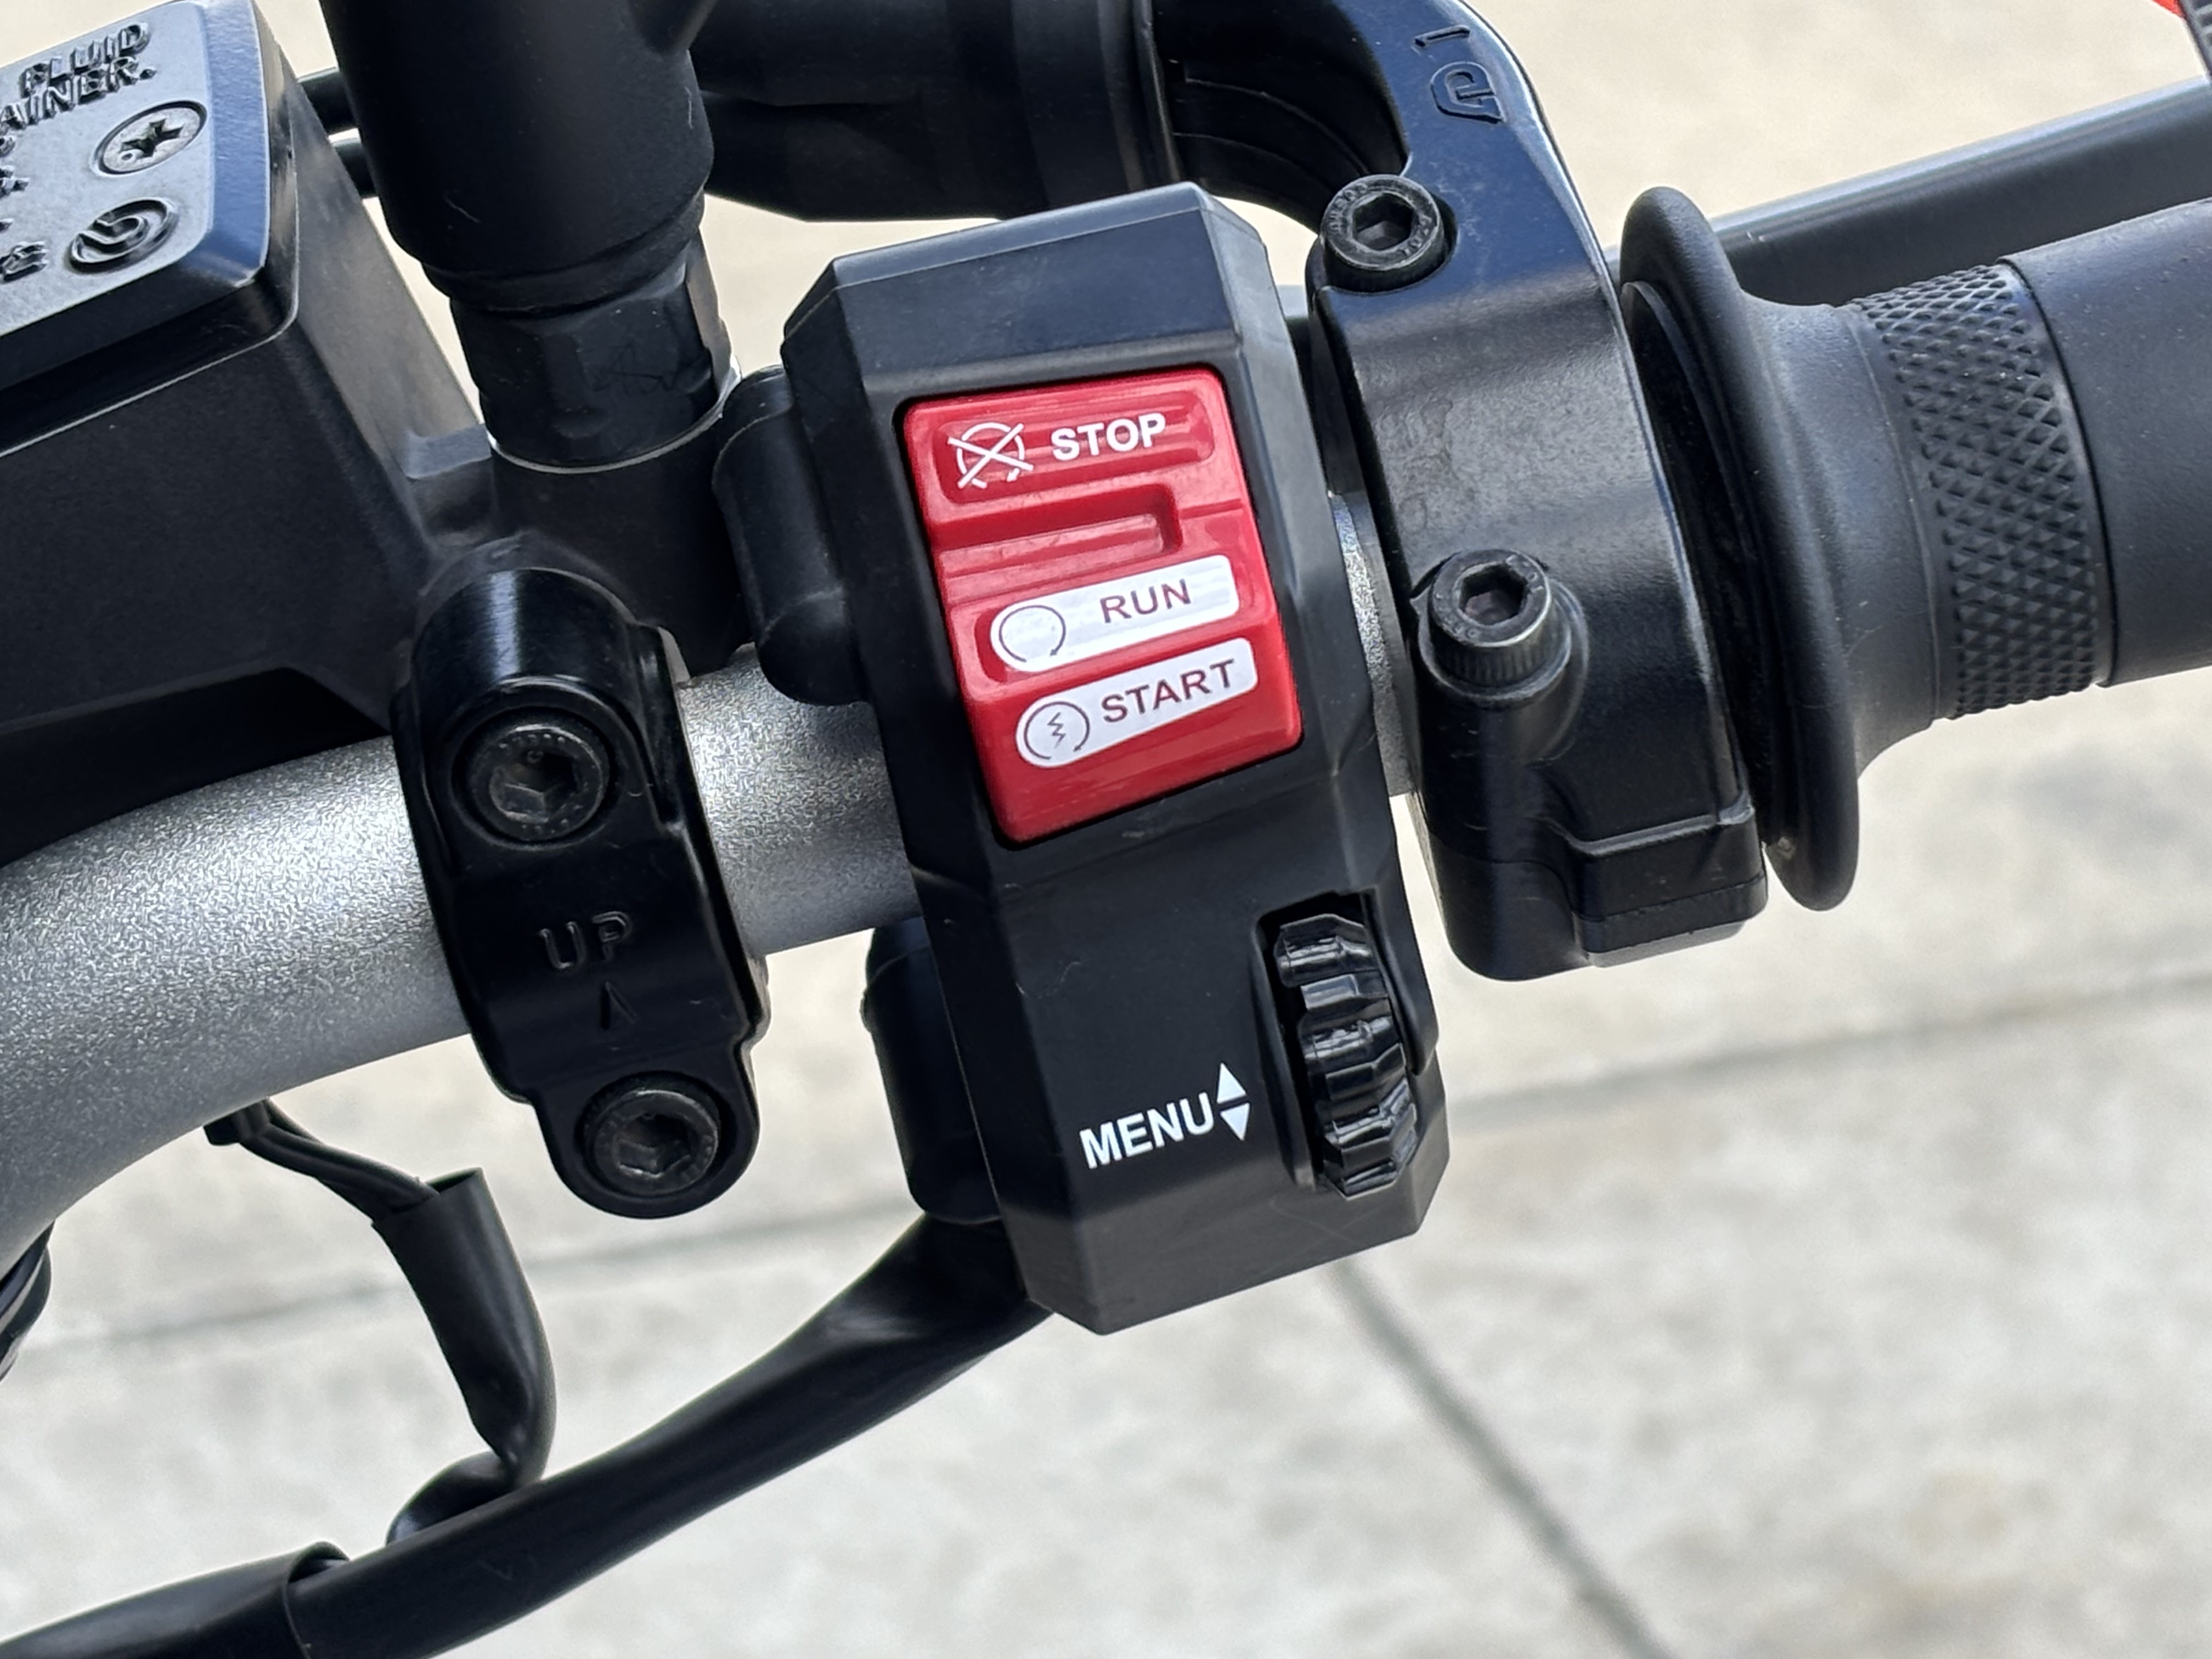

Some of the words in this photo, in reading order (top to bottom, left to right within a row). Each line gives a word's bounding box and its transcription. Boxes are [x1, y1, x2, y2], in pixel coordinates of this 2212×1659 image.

[19, 22, 152, 99] FLUID
[1051, 413, 1166, 461] STOP
[1100, 578, 1192, 623] RUN
[1102, 658, 1235, 723] START
[538, 910, 632, 970] UP
[1079, 1092, 1215, 1170] MENU
